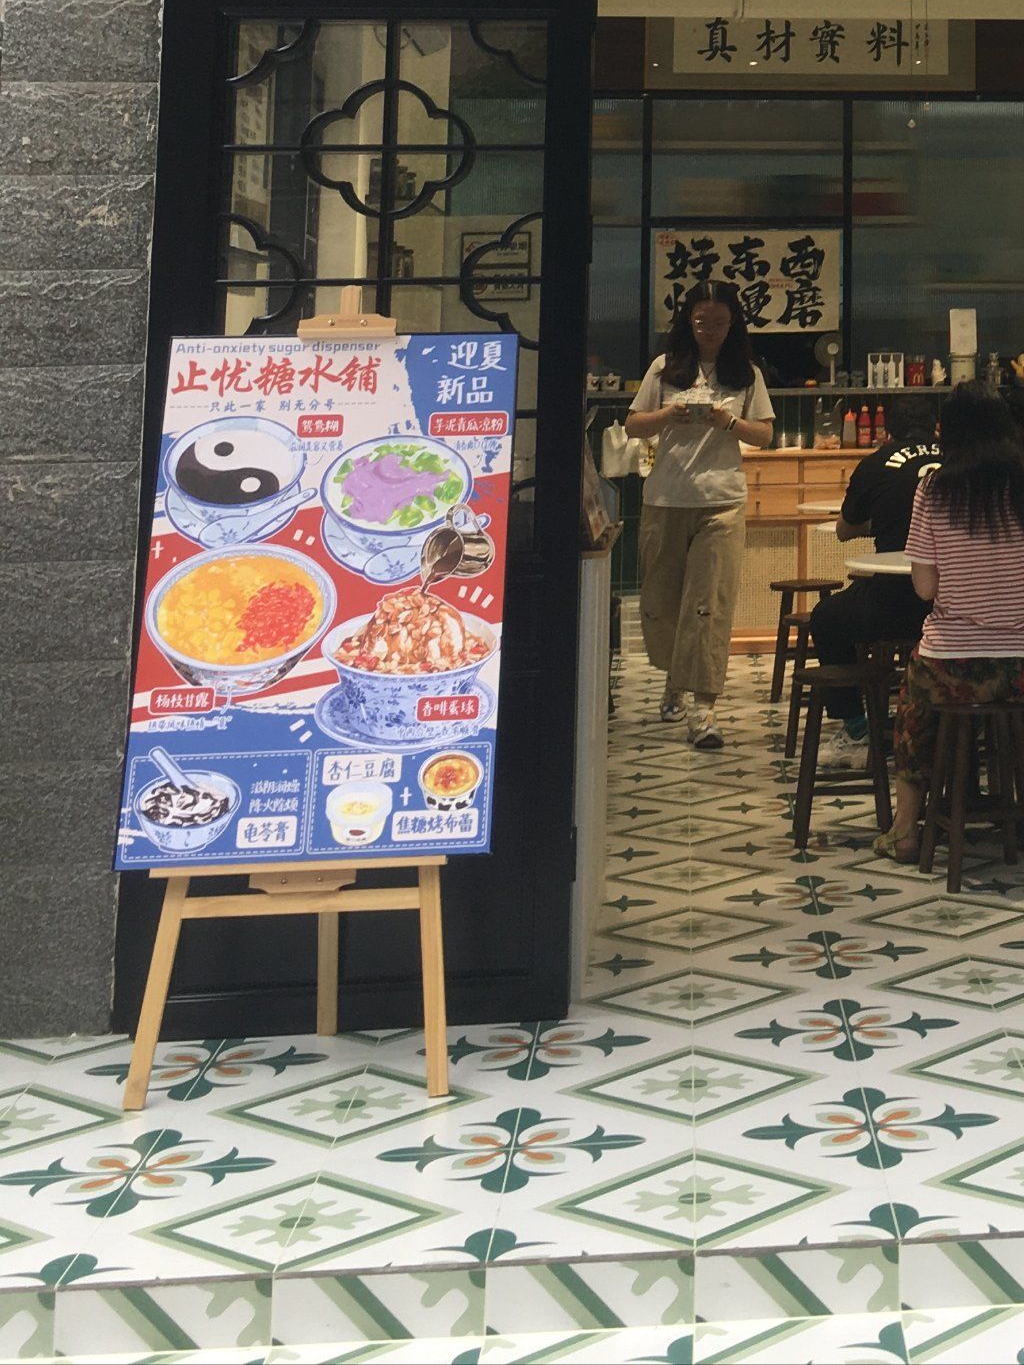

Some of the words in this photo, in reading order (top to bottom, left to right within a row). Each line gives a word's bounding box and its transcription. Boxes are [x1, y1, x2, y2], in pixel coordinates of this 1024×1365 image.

[663, 235, 826, 282] 好东西
[175, 341, 265, 356] Anti-anxiety
[268, 342, 308, 356] sugar
[311, 340, 381, 355] dispenser
[446, 340, 507, 371] 迎夏
[436, 374, 494, 405] 新品
[154, 691, 210, 709] 杨枝甘露
[326, 757, 397, 782] 杏仁豆腐
[243, 819, 290, 844] 龟苓膏
[395, 812, 475, 835] 焦糖烤布蕾
